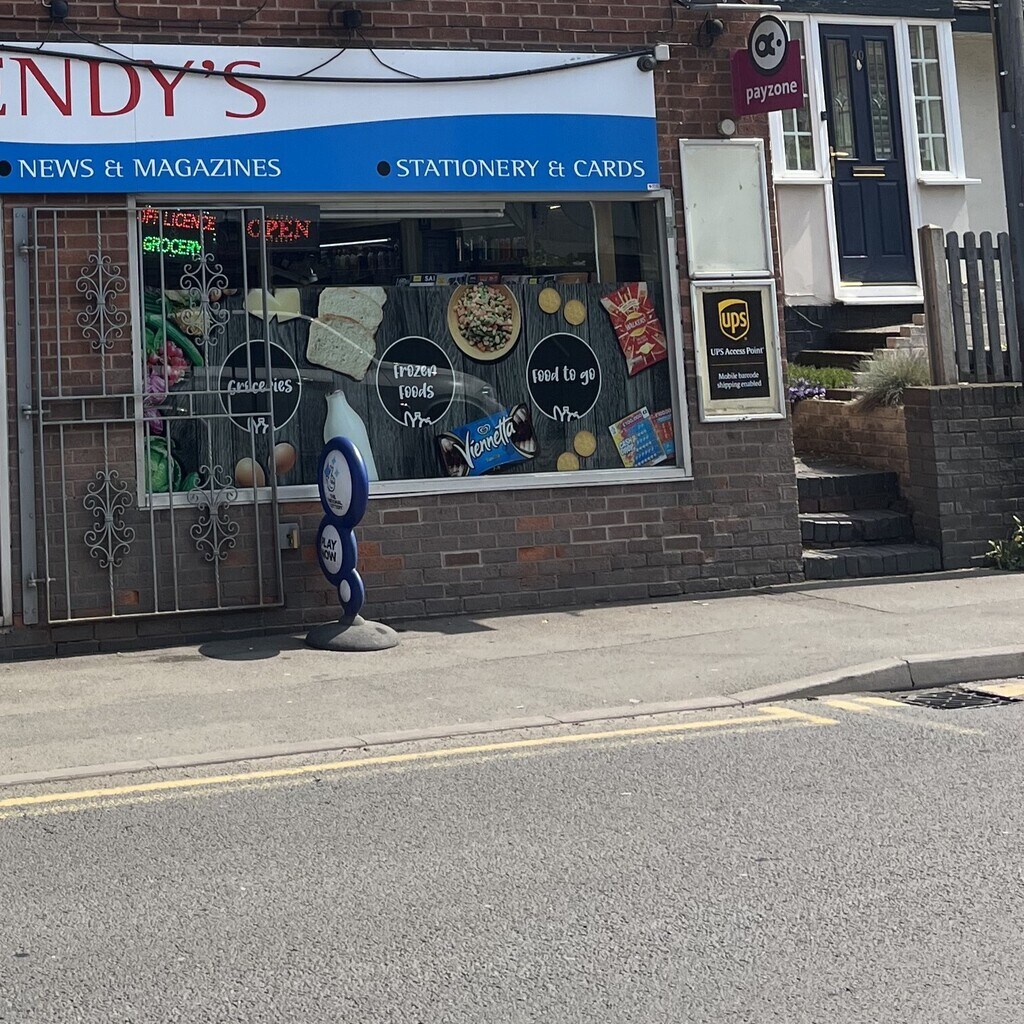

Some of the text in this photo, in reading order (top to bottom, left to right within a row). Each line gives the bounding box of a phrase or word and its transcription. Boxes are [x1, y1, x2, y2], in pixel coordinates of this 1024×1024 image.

[746, 81, 798, 105] payzone
[19, 158, 282, 178] NEWS & MAGAZINES
[396, 159, 646, 178] STATIONERY & CARDS
[247, 219, 311, 239] OPEN
[142, 236, 202, 256] GROCERY
[721, 311, 748, 334] ups
[710, 346, 764, 356] UPS Access Point
[393, 362, 437, 379] Frozen
[532, 365, 596, 386] Food to go
[718, 373, 738, 381] Mobile
[399, 382, 435, 400] Foods
[717, 380, 762, 390] shipping enabled
[453, 416, 516, 469] Viennetta
[321, 536, 337, 551] PLAY
